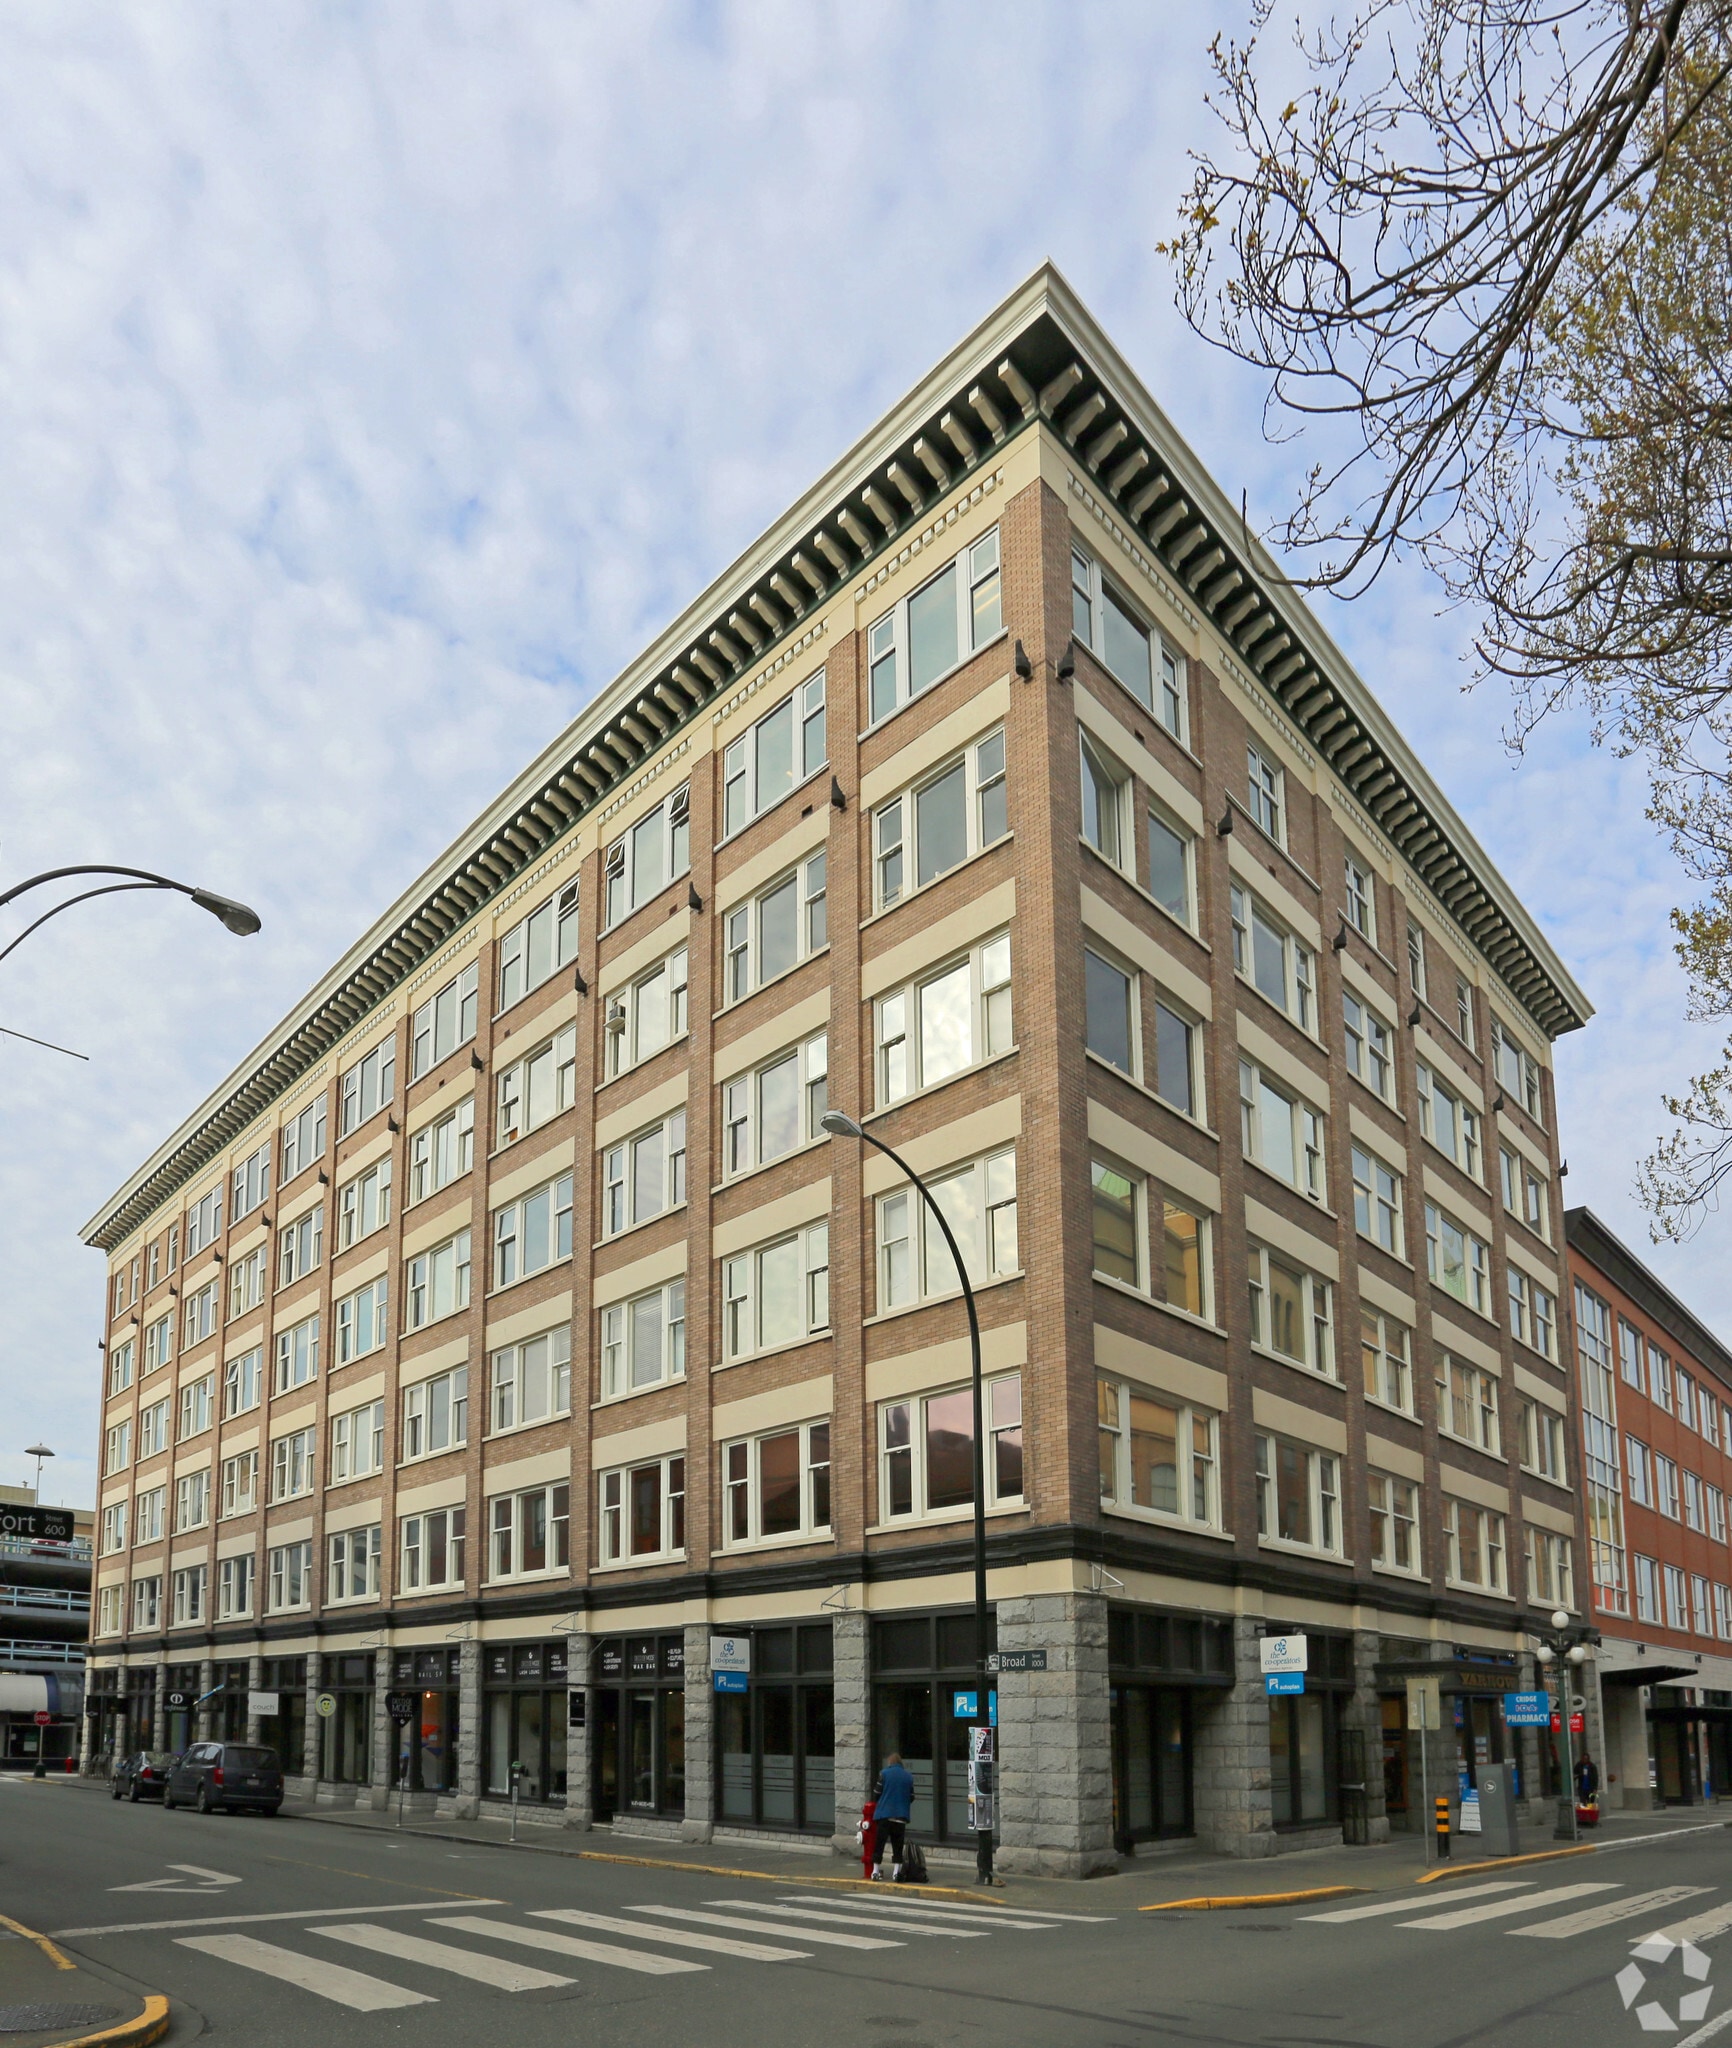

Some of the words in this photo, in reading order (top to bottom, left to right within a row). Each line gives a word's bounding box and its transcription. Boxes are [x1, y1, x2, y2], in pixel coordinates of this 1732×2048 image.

[0, 1509, 36, 1532] ort
[44, 1525, 66, 1536] 600
[1001, 1655, 1026, 1667] Broad
[1515, 1695, 1537, 1703] CRIDGE
[1506, 1713, 1548, 1723] PHARMACY
